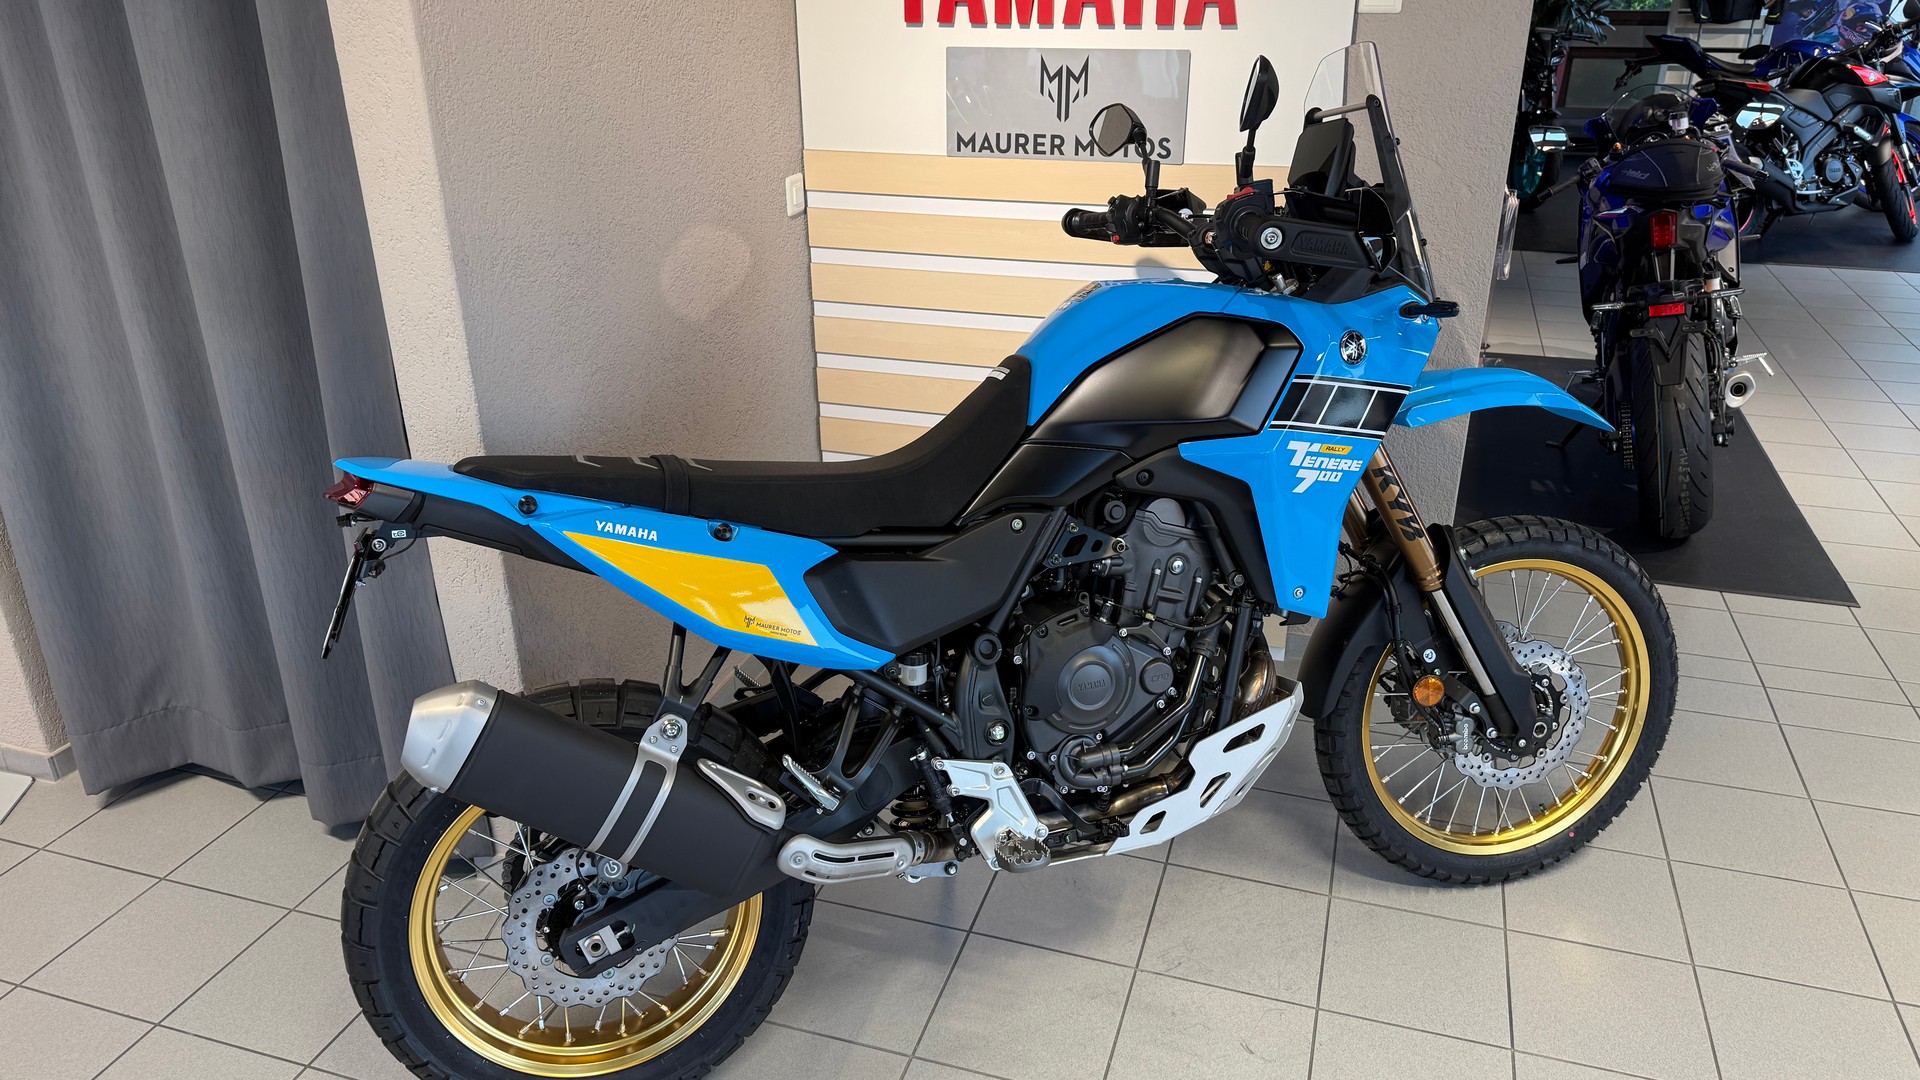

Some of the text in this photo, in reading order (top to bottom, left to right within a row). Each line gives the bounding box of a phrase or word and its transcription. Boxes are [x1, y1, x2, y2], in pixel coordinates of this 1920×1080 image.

[956, 131, 1172, 159] MAURER MOS
[1300, 236, 1348, 255] YAMAHA
[1292, 469, 1343, 494] 700
[1371, 464, 1425, 541] KYB
[595, 520, 658, 542] YAMAHA
[756, 622, 780, 632] MAURER
[781, 627, 801, 636] MOTOS
